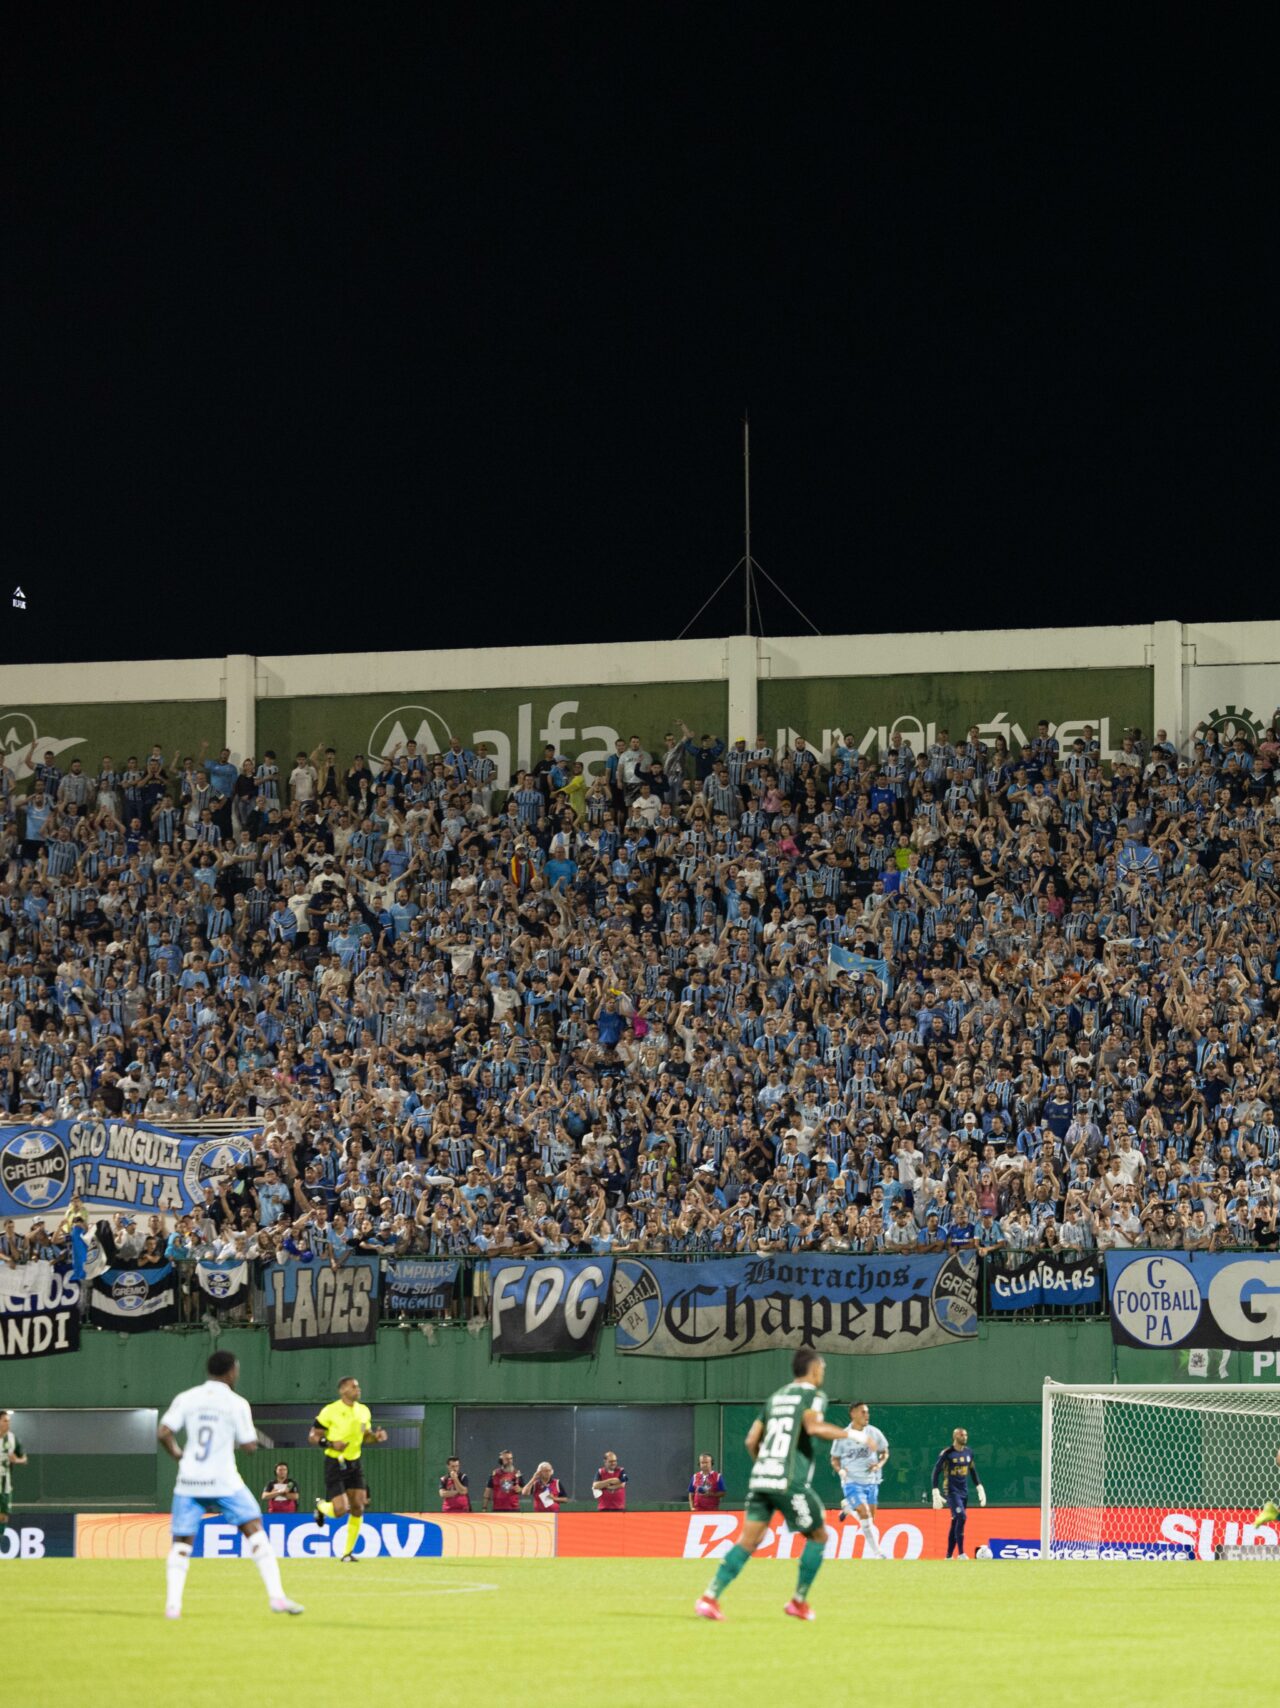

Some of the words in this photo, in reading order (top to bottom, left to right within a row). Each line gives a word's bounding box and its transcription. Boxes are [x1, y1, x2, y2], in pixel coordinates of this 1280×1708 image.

[472, 701, 622, 791] alfa
[107, 1124, 182, 1170] MIGUEL
[3, 1156, 65, 1180] GRÊMIO
[73, 1163, 183, 1209] ALENTA
[744, 1258, 911, 1293] Borrachos
[995, 1260, 1096, 1297] GUAÍBA-RS
[1147, 1259, 1166, 1289] G
[273, 1265, 373, 1340] LAGES
[493, 1265, 604, 1340] FDG
[1117, 1289, 1197, 1315] FOOTBALL
[195, 1426, 213, 1461] 9
[758, 1417, 794, 1458] 26
